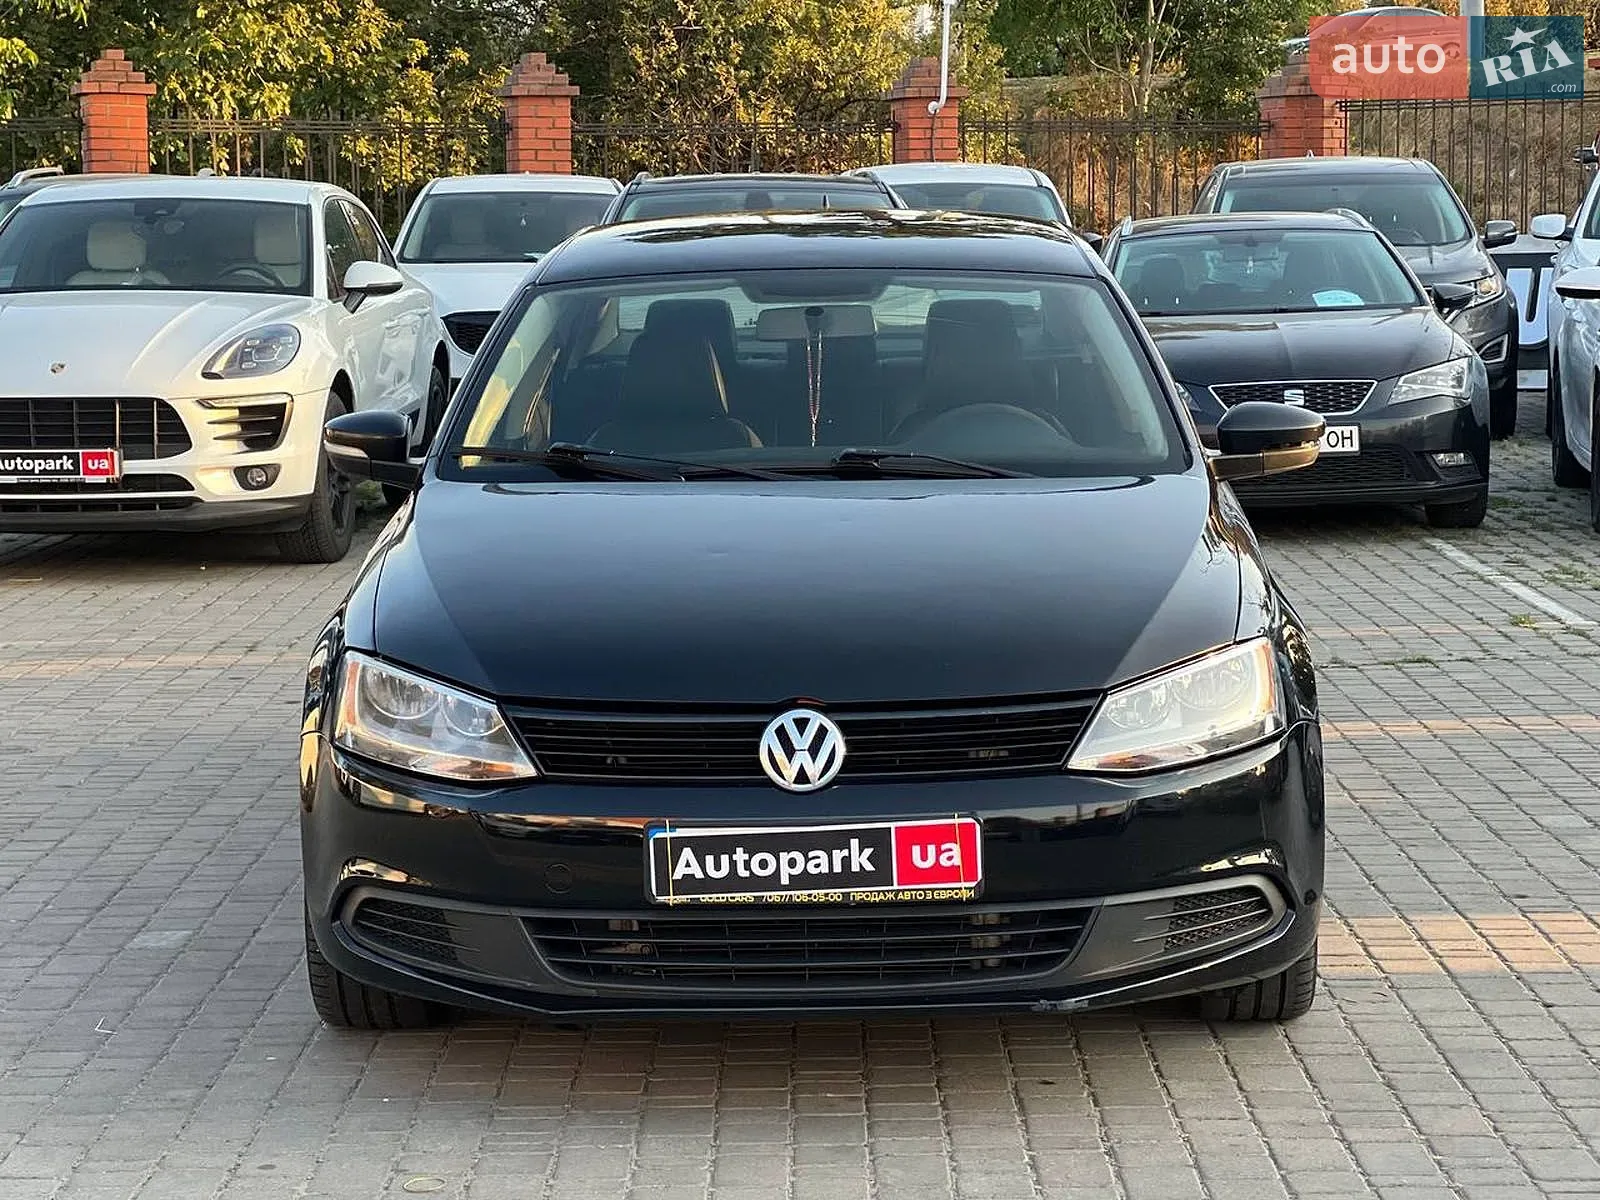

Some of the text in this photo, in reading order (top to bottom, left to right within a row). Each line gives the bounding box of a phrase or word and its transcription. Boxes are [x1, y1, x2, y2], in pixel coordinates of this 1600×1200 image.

[1326, 430, 1353, 448] OH
[87, 458, 109, 470] ua
[672, 838, 962, 885] Autopark ua
[850, 890, 896, 902] ПРОДАЖ
[897, 889, 924, 900] АВТО
